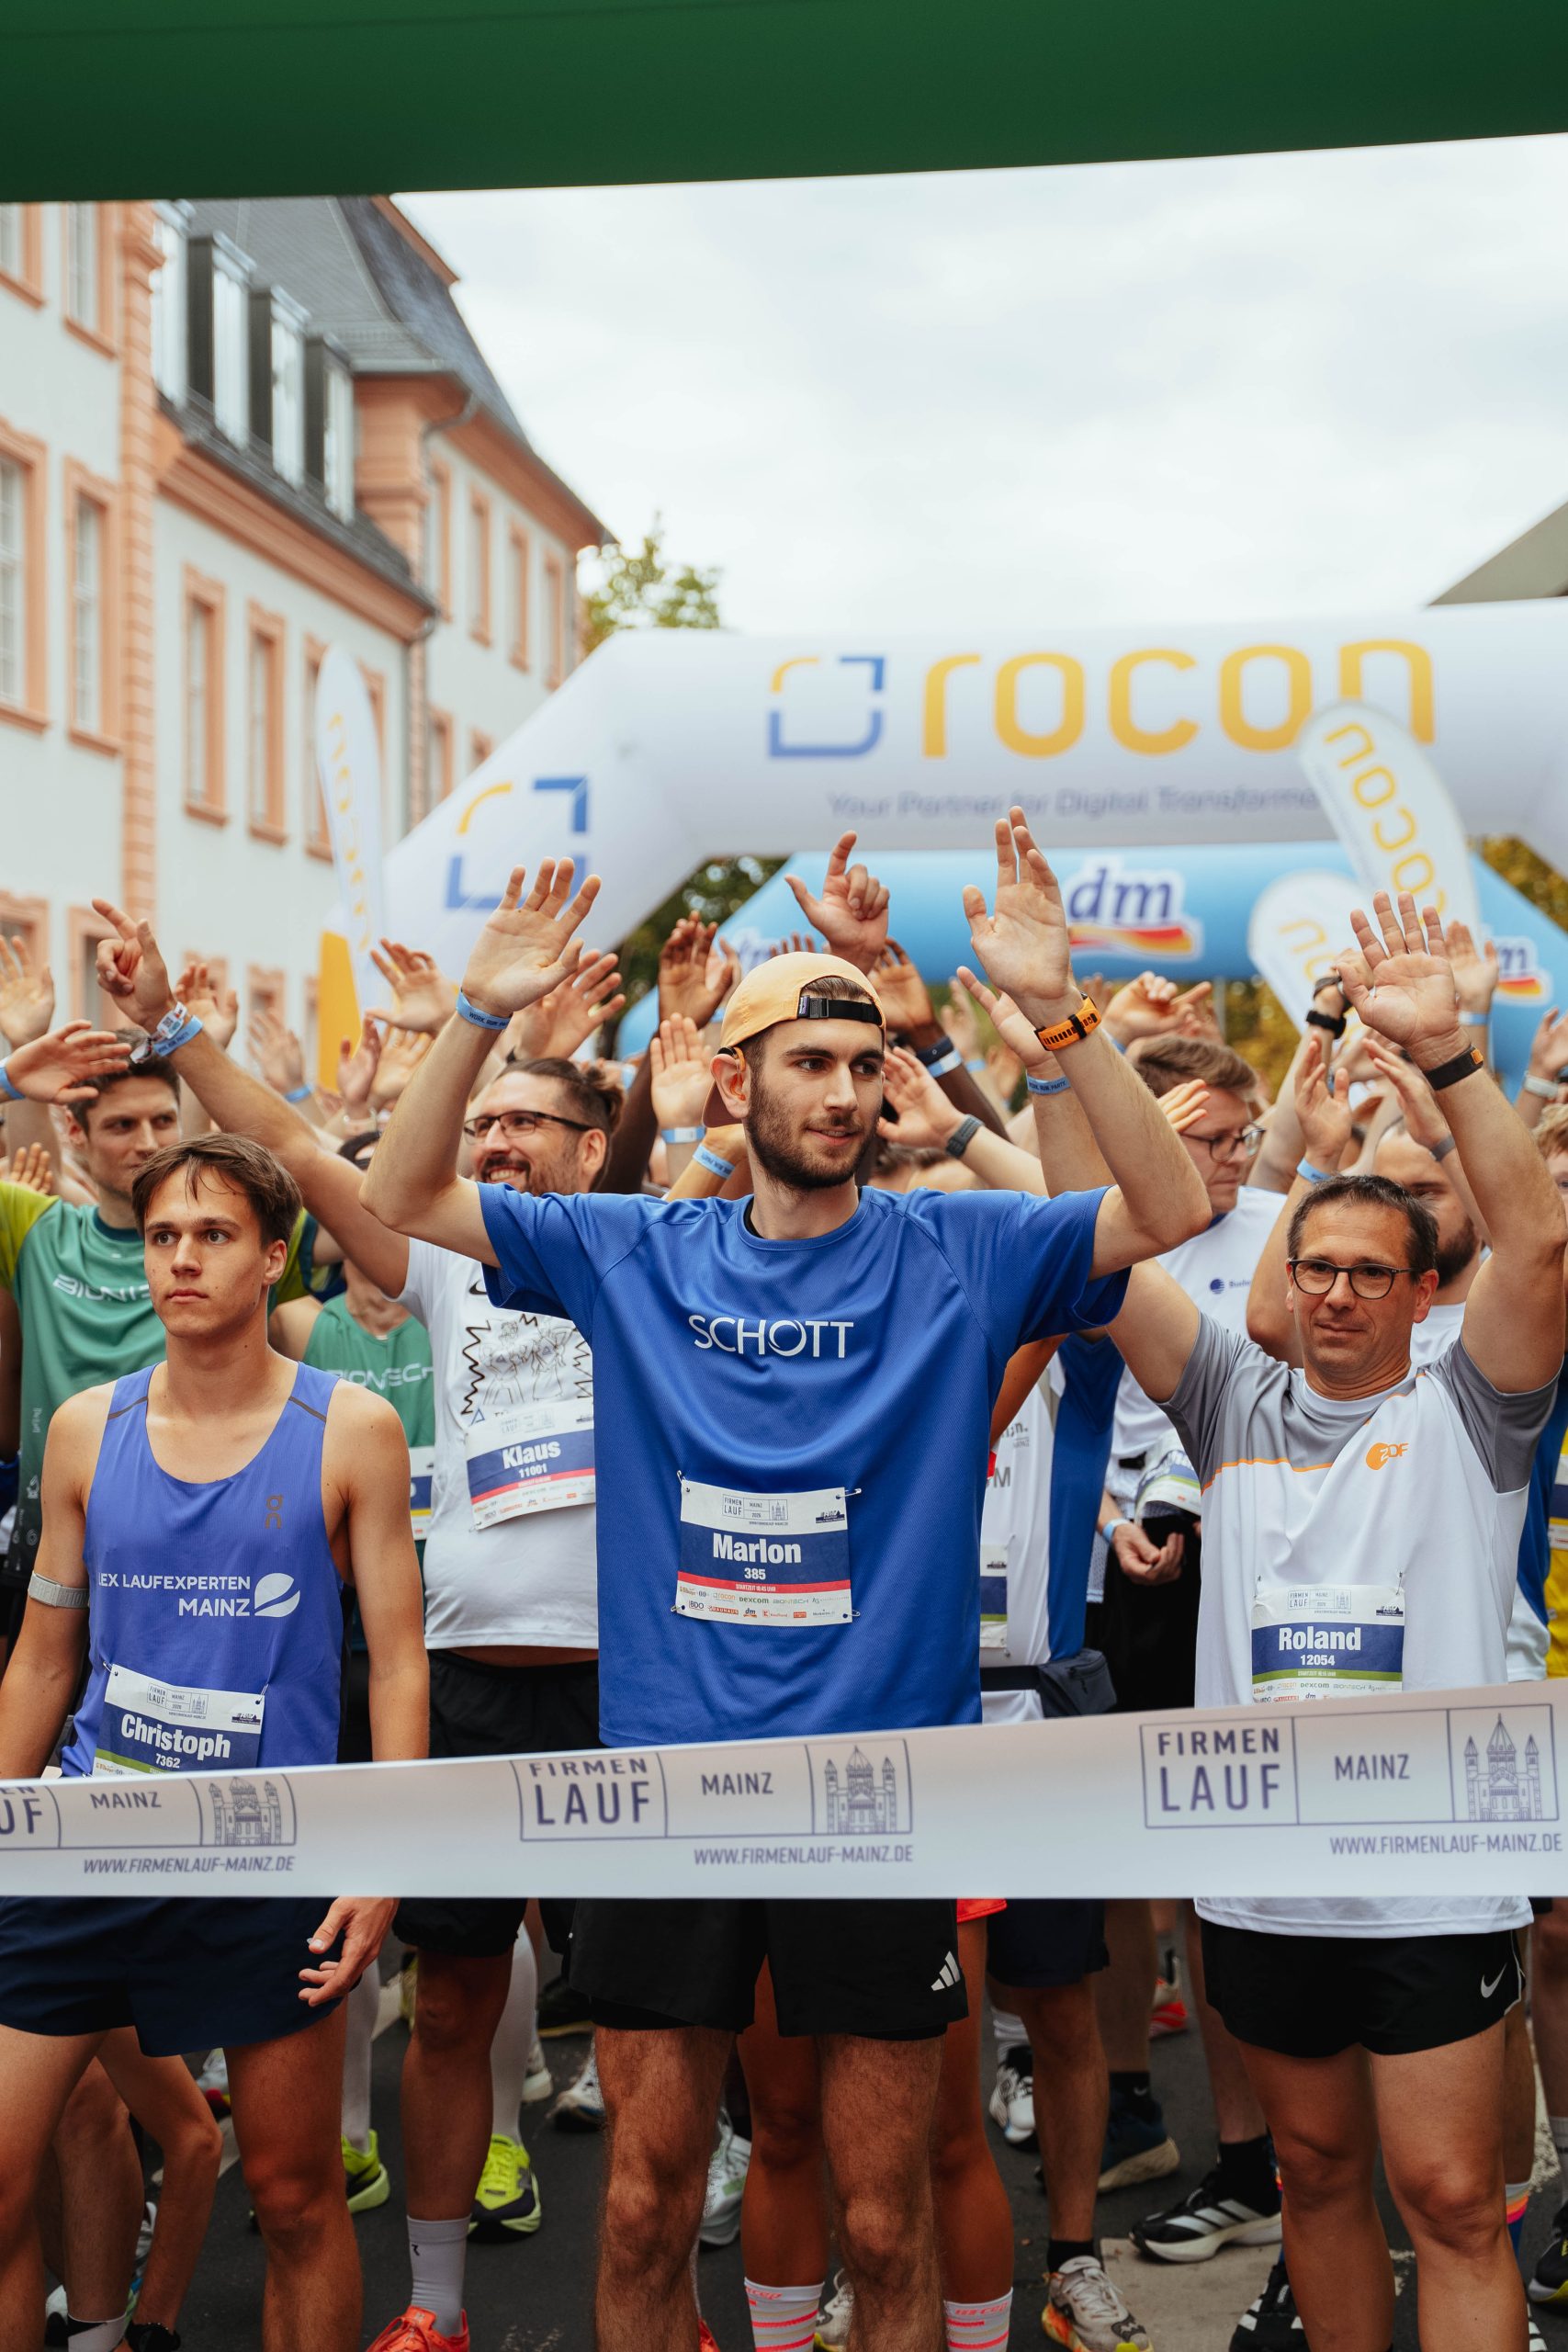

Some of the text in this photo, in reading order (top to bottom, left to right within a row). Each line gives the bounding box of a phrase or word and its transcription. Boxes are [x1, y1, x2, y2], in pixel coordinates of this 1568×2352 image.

[921, 639, 1436, 759] rocon
[897, 790, 1001, 819] Partner
[1054, 788, 1148, 820] Digital
[1069, 866, 1171, 921] dm
[689, 1315, 854, 1358] SCHOTT
[502, 1441, 562, 1470] Klaus
[1380, 1442, 1409, 1462] ZDF
[518, 1463, 548, 1478] 11001
[724, 1505, 742, 1516] LAUF
[713, 1532, 802, 1565] Marlon
[122, 1574, 251, 1590] LAUFEXPERTEN
[743, 1567, 766, 1580] 385
[178, 1598, 251, 1617] MAINZ
[1289, 1599, 1309, 1608] LAUF
[1279, 1625, 1361, 1651] Roland
[1300, 1654, 1336, 1666] 12054
[148, 1692, 165, 1705] LAUF
[121, 1713, 231, 1761] Christoph
[1157, 1727, 1280, 1757] FIRMEN
[155, 1753, 181, 1769] 7362
[530, 1758, 648, 1778] FIRMEN
[1334, 1753, 1411, 1781] MAINZ
[702, 1772, 774, 1796] MAINZ
[1159, 1763, 1281, 1813] LAUF
[89, 1792, 163, 1809] MAINZ
[535, 1781, 650, 1826] LAUF
[694, 1844, 914, 1866] WWW.FIRMENLAUF-MAINZ.DE
[1329, 1833, 1563, 1856] WWW.FIRMENLAUF-MAINZ.DE
[84, 1855, 296, 1874] WWW.FIRMENLAUF-MAINZ.DE
